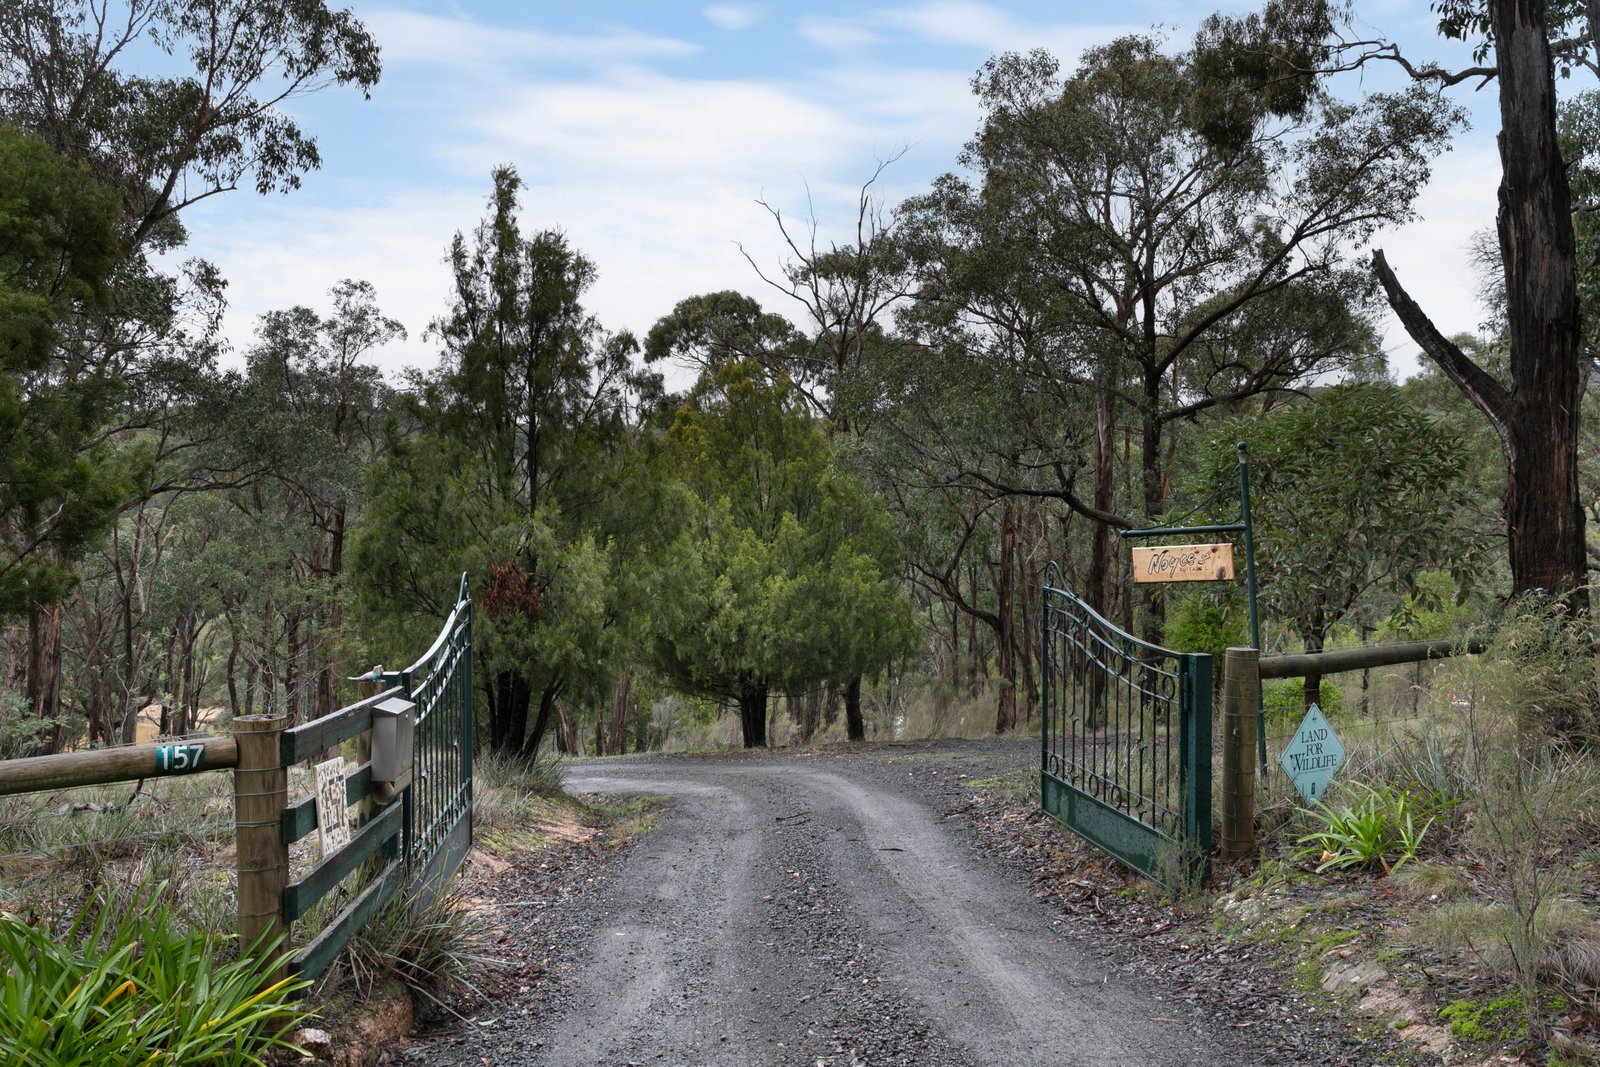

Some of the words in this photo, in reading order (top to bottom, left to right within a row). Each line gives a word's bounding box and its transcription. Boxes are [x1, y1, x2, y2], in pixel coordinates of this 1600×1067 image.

[1301, 728, 1328, 744] LAND
[161, 744, 205, 770] 157
[1306, 743, 1323, 756] FOR
[1289, 753, 1337, 772] WILDLIFE
